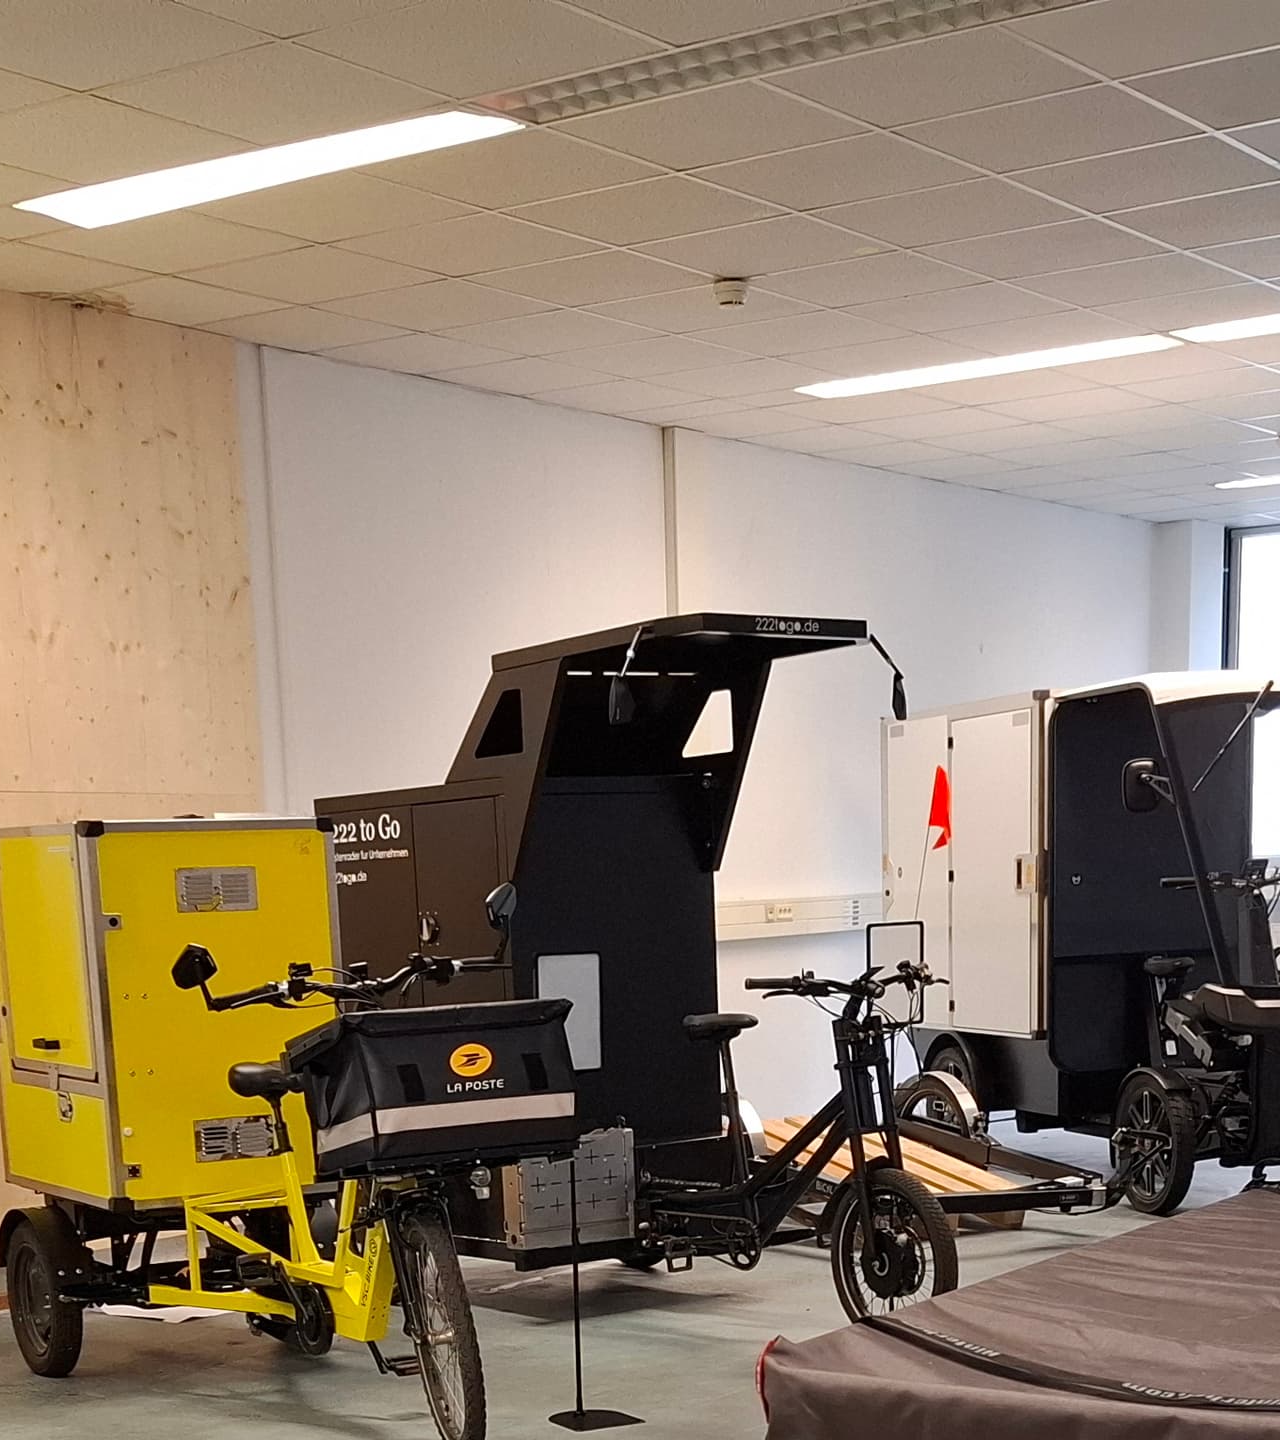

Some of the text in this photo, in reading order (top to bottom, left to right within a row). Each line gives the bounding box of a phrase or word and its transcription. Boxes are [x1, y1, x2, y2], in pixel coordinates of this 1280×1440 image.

[359, 818, 376, 842] to
[378, 813, 401, 840] Go
[446, 1079, 505, 1093] LA POSTE
